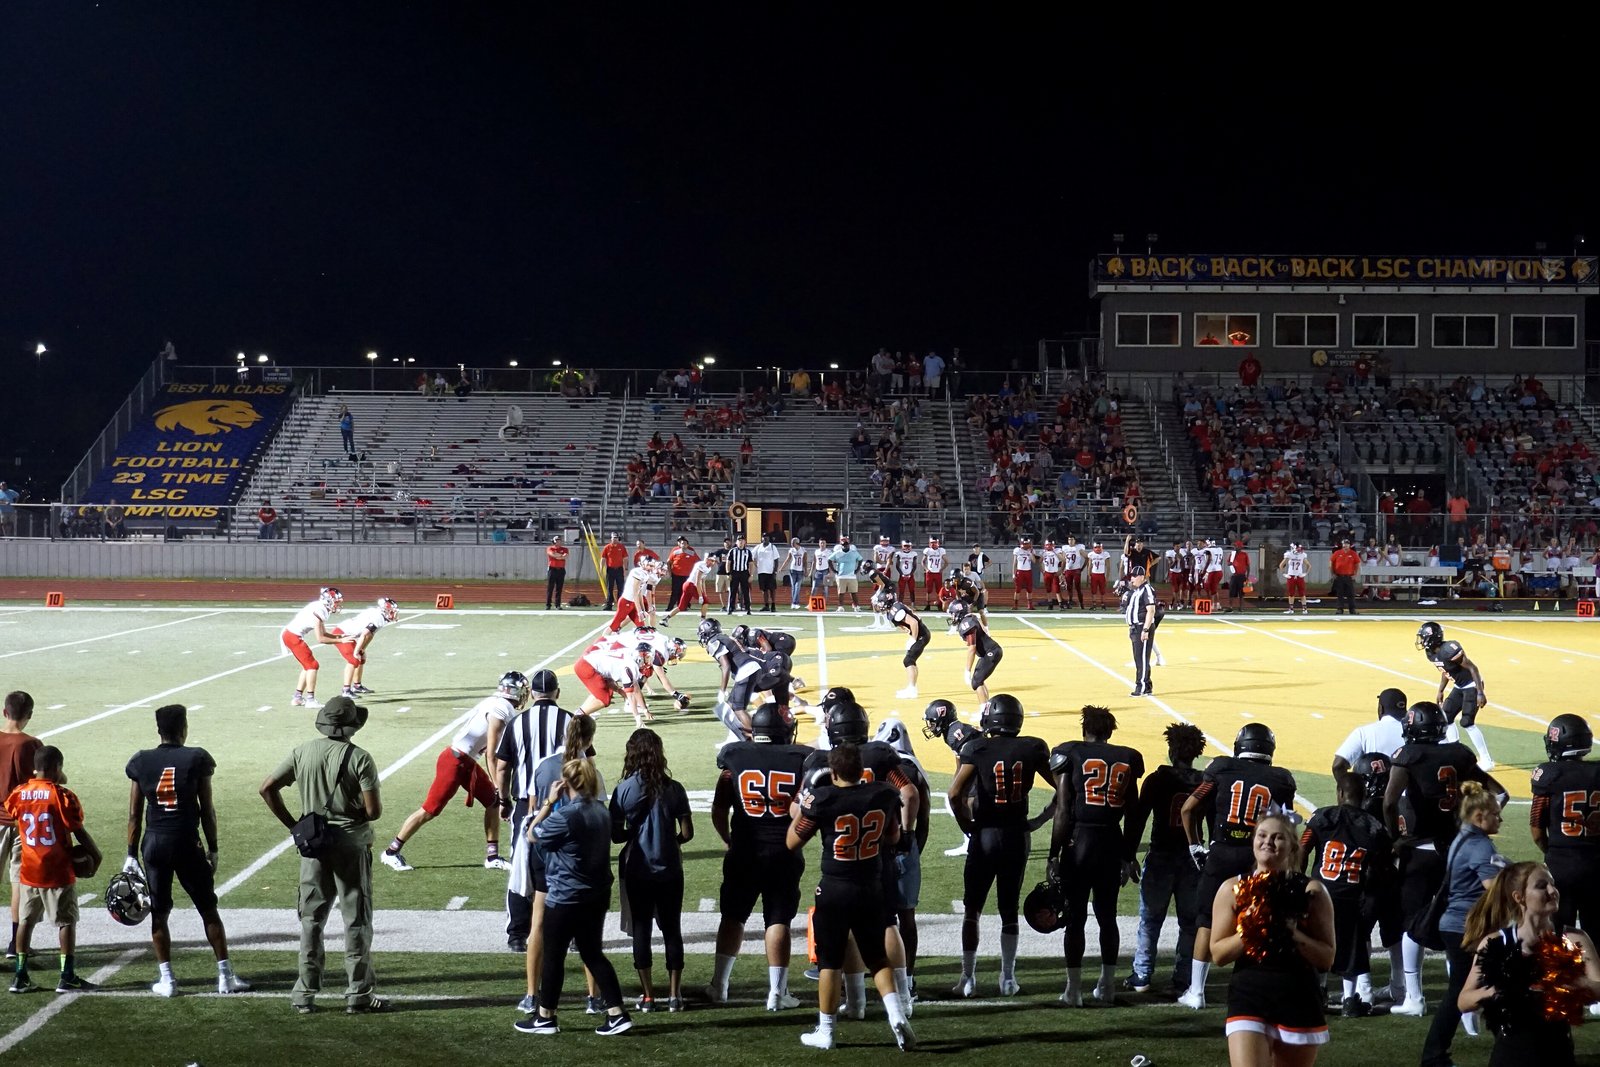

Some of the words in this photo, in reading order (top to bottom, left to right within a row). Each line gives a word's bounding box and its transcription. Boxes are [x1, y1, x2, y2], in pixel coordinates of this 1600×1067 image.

[1130, 257, 1195, 277] BACK
[1196, 262, 1208, 272] to
[1210, 257, 1276, 277] BACK
[1277, 262, 1289, 272] to
[1290, 257, 1356, 278] BACK
[1362, 258, 1411, 278] LSC
[1417, 258, 1566, 279] CHAMPIONS
[167, 384, 206, 393] BEST
[211, 384, 230, 393] IN
[233, 384, 287, 394] CLASS
[156, 442, 223, 452] LION
[112, 457, 240, 468] FOOTBALL
[112, 472, 146, 483] 23
[161, 473, 229, 484] TIME
[131, 489, 188, 500] LSC
[49, 594, 60, 605] 10
[437, 596, 450, 607] 20
[811, 598, 824, 609] 30
[1197, 601, 1210, 612] 40
[1579, 604, 1592, 615] 50
[993, 760, 1024, 804] 11
[1082, 758, 1132, 808] 28
[156, 767, 178, 811] 4
[738, 769, 796, 818] 65
[1227, 780, 1272, 827] 10
[22, 812, 57, 847] 23
[833, 809, 886, 861] 22
[1319, 840, 1367, 884] 84
